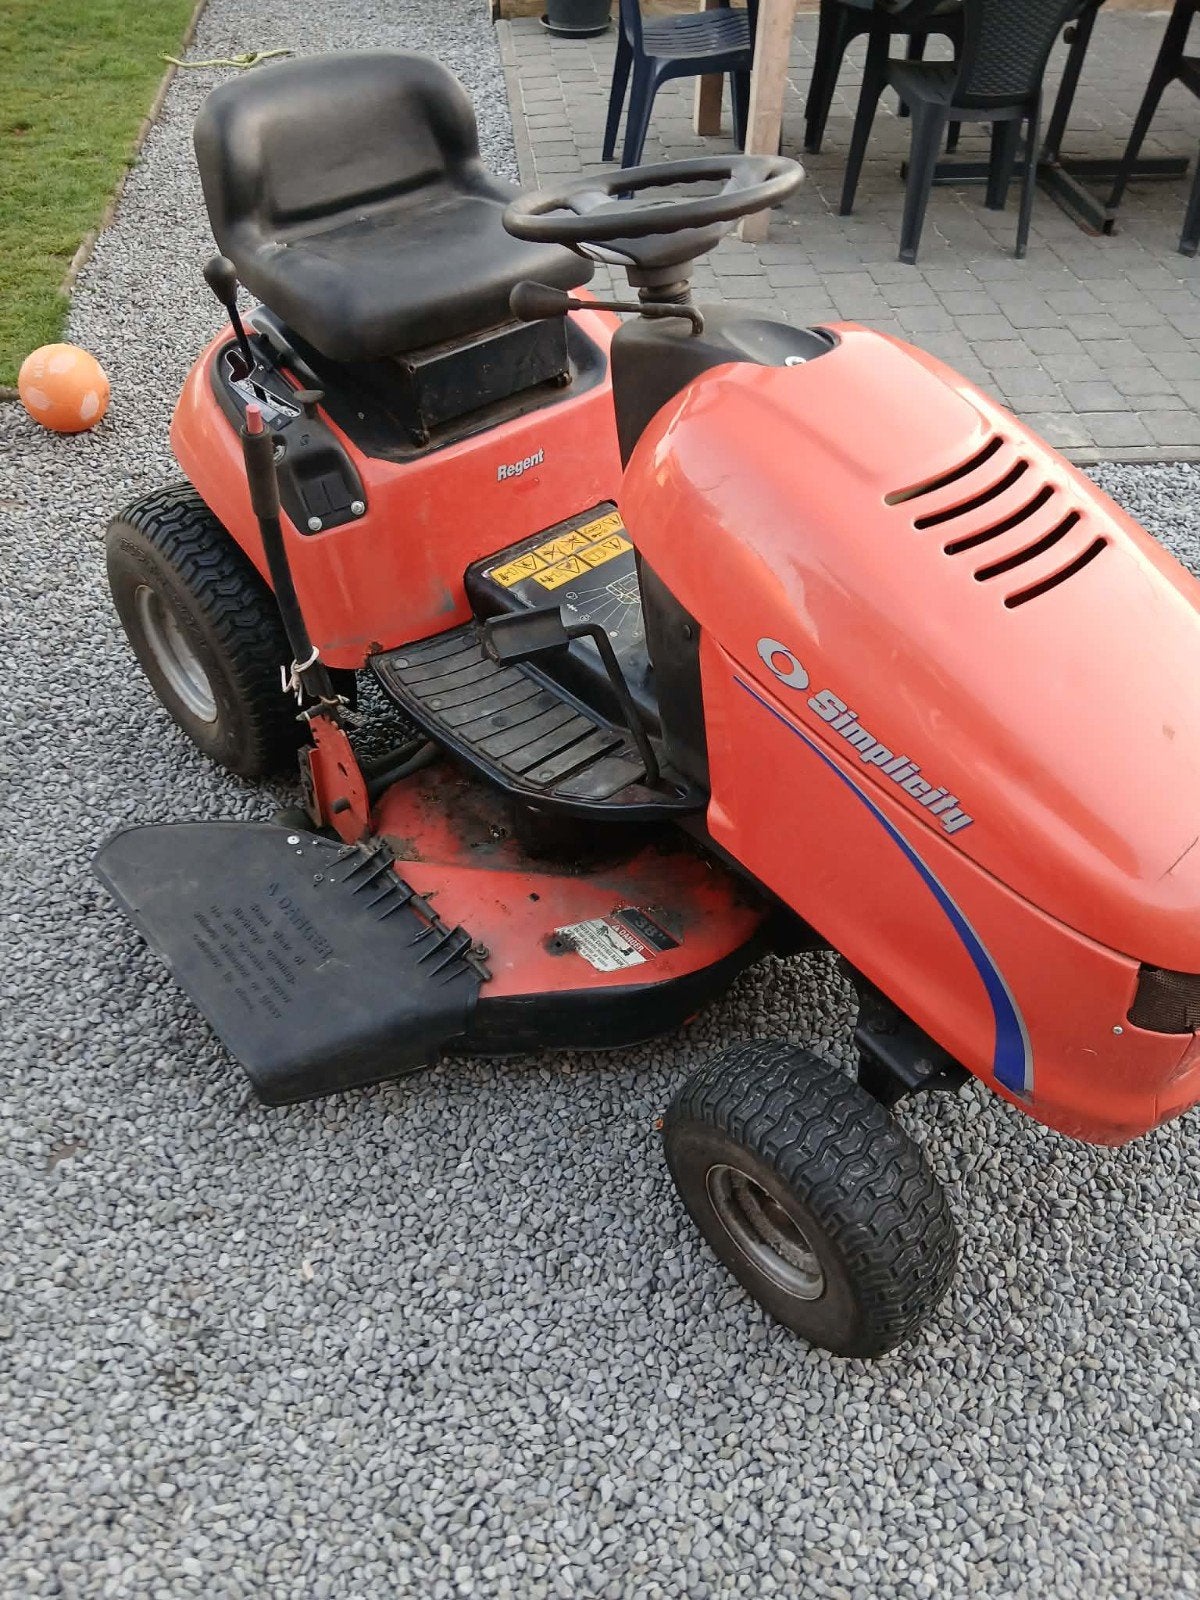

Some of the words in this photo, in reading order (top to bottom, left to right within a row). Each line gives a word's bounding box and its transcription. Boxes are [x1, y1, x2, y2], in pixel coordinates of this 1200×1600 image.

[497, 448, 544, 482] Regent
[807, 688, 974, 834] Simplicity
[619, 928, 644, 952] DANGER
